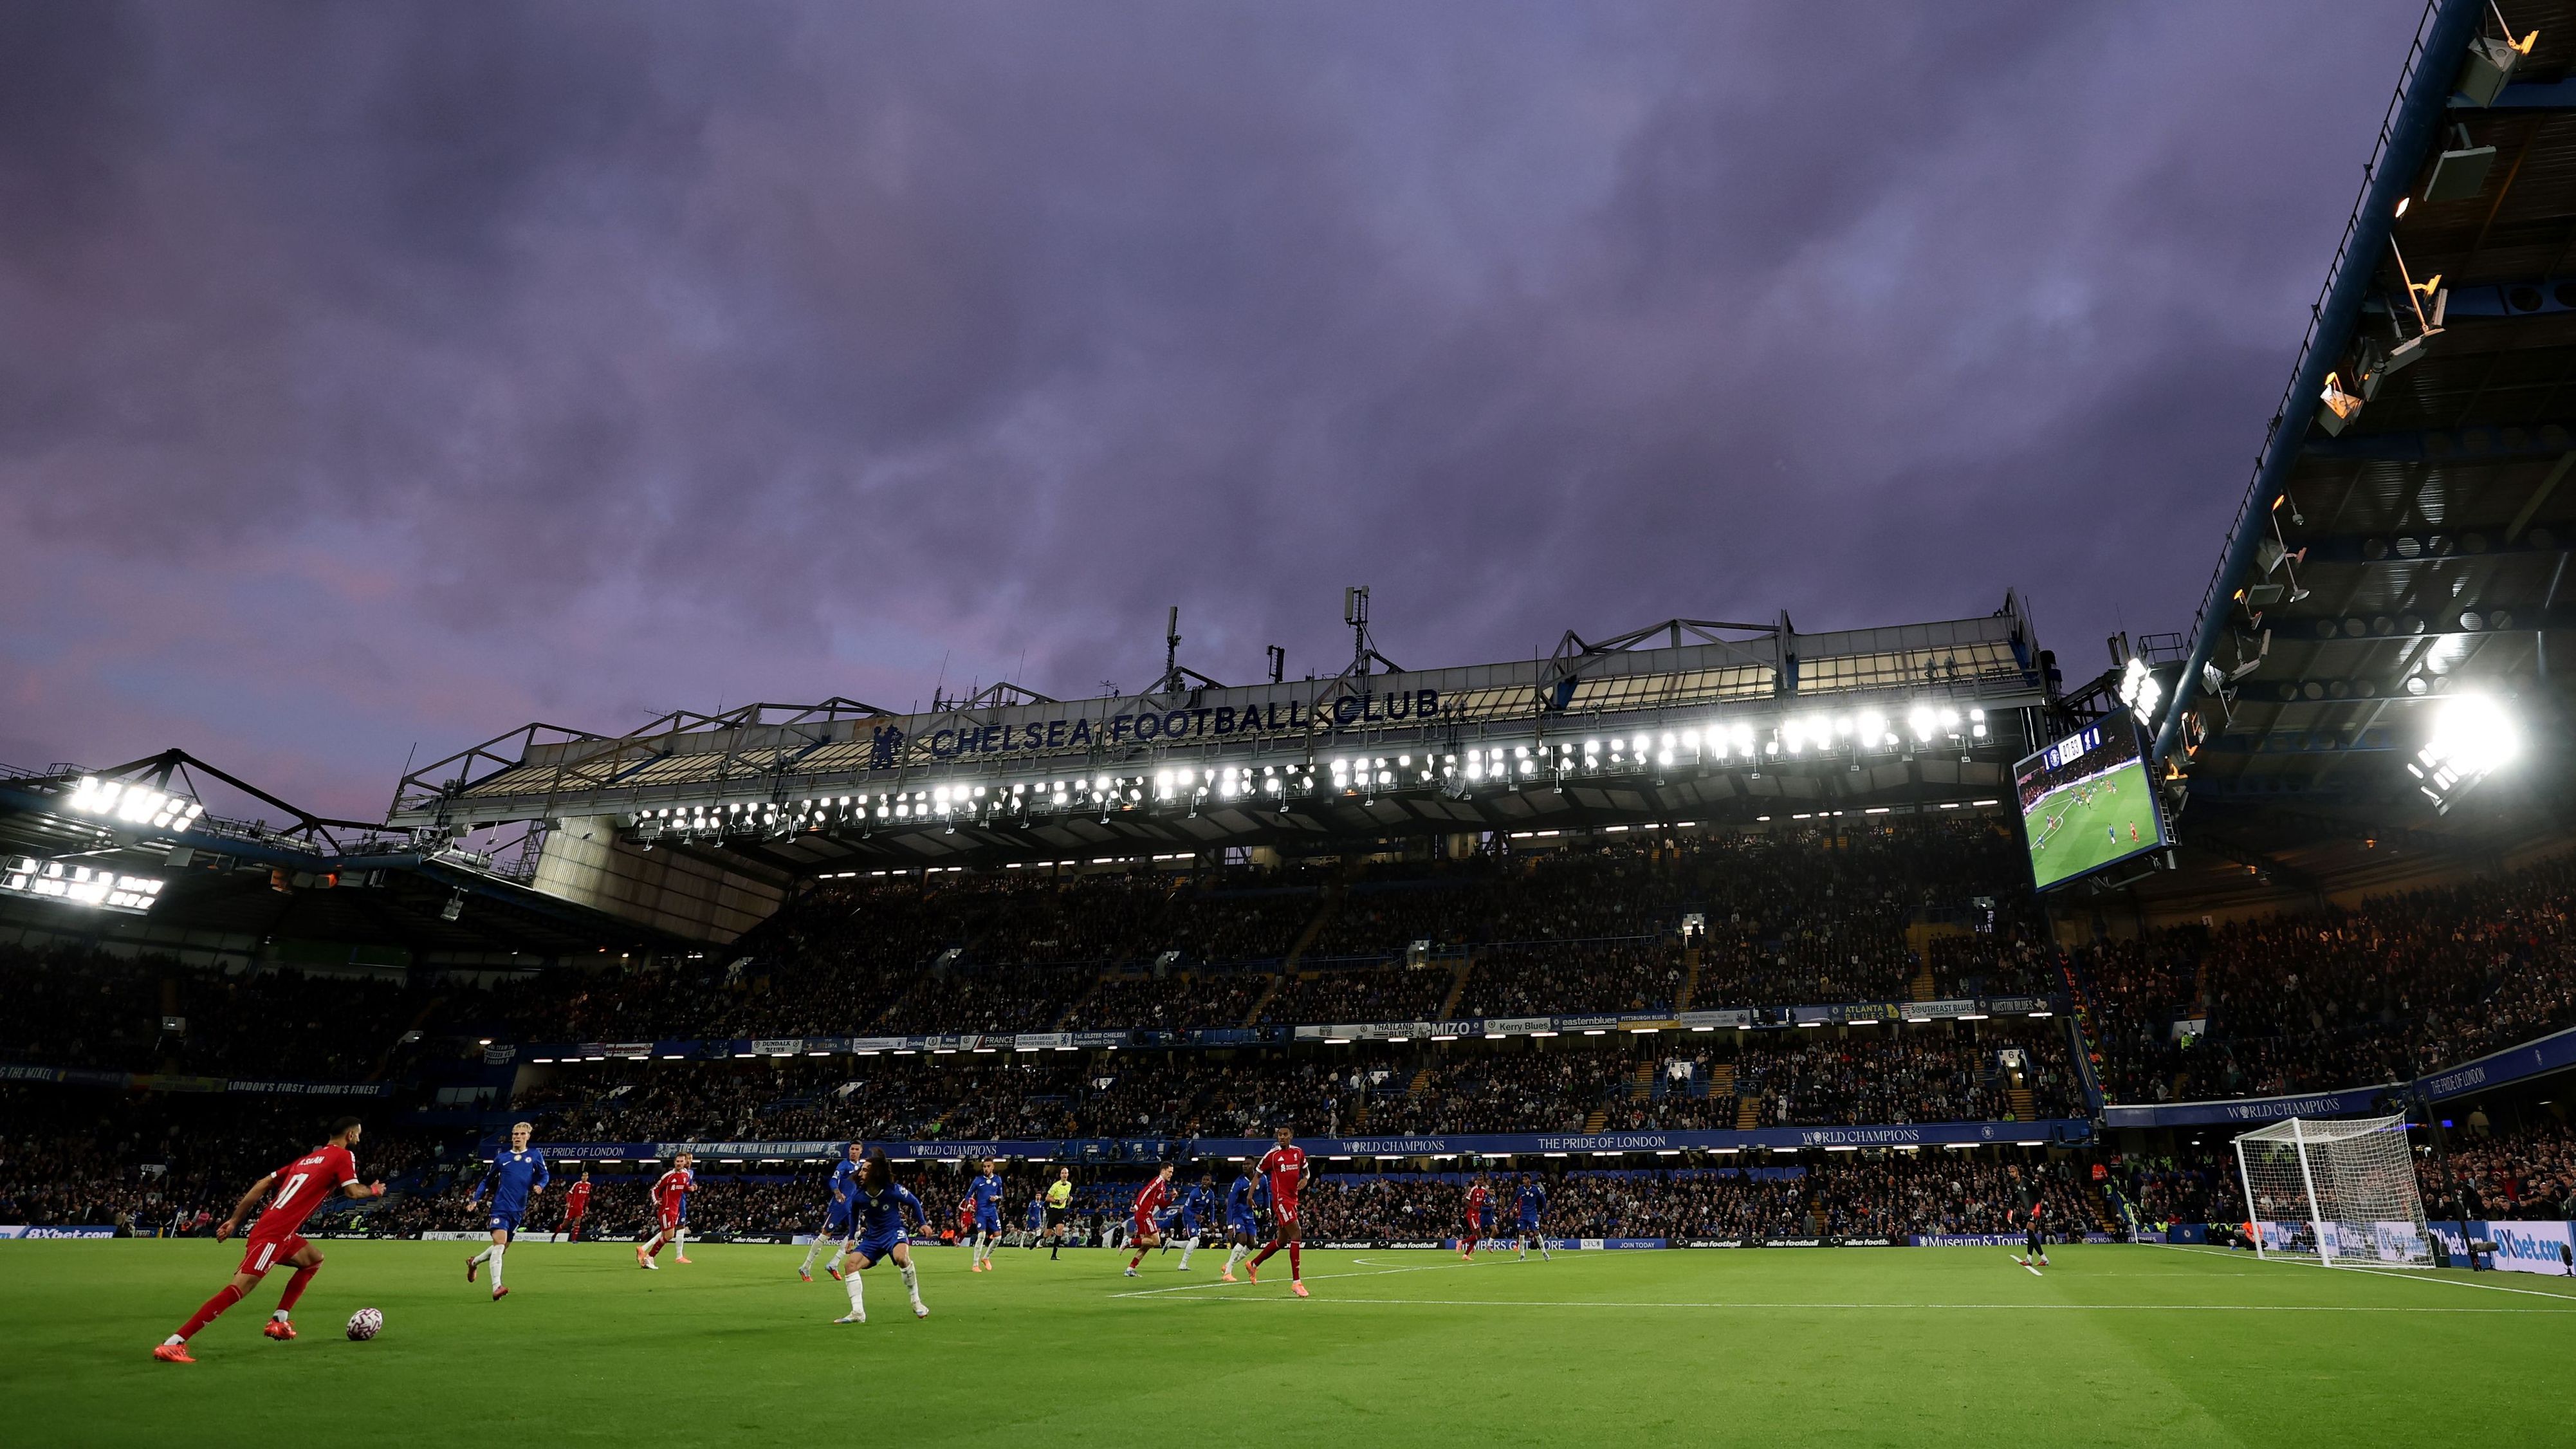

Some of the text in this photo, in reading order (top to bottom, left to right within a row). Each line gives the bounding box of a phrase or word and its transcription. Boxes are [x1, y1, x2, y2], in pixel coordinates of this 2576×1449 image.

[932, 689, 1439, 756] CHELSEA FOOTBALL CLUB
[1845, 1004, 1884, 1013] ATLANTA
[1911, 1004, 1952, 1013] SOUTHEAST
[1992, 1000, 2034, 1012] AUSTIN BLUES
[1562, 1016, 1617, 1026] easternblues
[1431, 1022, 1470, 1036] MIZO
[1500, 1022, 1522, 1032] Kerry
[984, 1036, 1015, 1044] FRANCE
[2008, 1051, 2014, 1059] 6
[1679, 1064, 1685, 1072] 5
[2431, 1067, 2487, 1095] THE PRIDE OF LONDON
[227, 1081, 274, 1092] LONDON'S
[306, 1084, 349, 1095] LONDON'S
[350, 1085, 380, 1095] FINEST
[2227, 1098, 2340, 1118] WORLD CHAMPIONS
[1801, 1129, 1919, 1144] WORLD CHAMPIONS
[1343, 1140, 1445, 1152] WORLD CHAMPIONS
[1538, 1136, 1666, 1149] THE PRIDE OF LONDON
[551, 1147, 576, 1158] PRIDE
[576, 1147, 589, 1157] OF
[589, 1147, 625, 1157] LONDON
[679, 1143, 825, 1154] THEY DON'T MAKE THEM LIKE RAY ANYMORE
[909, 1145, 997, 1156] WORLD CHAMPIONS
[26, 1228, 114, 1239] 8Xbet.com
[427, 1232, 447, 1241] CLUB
[1543, 1241, 1565, 1250] ORE
[1690, 1240, 1709, 1248] nike
[1928, 1235, 2029, 1247] Museum & Tours
